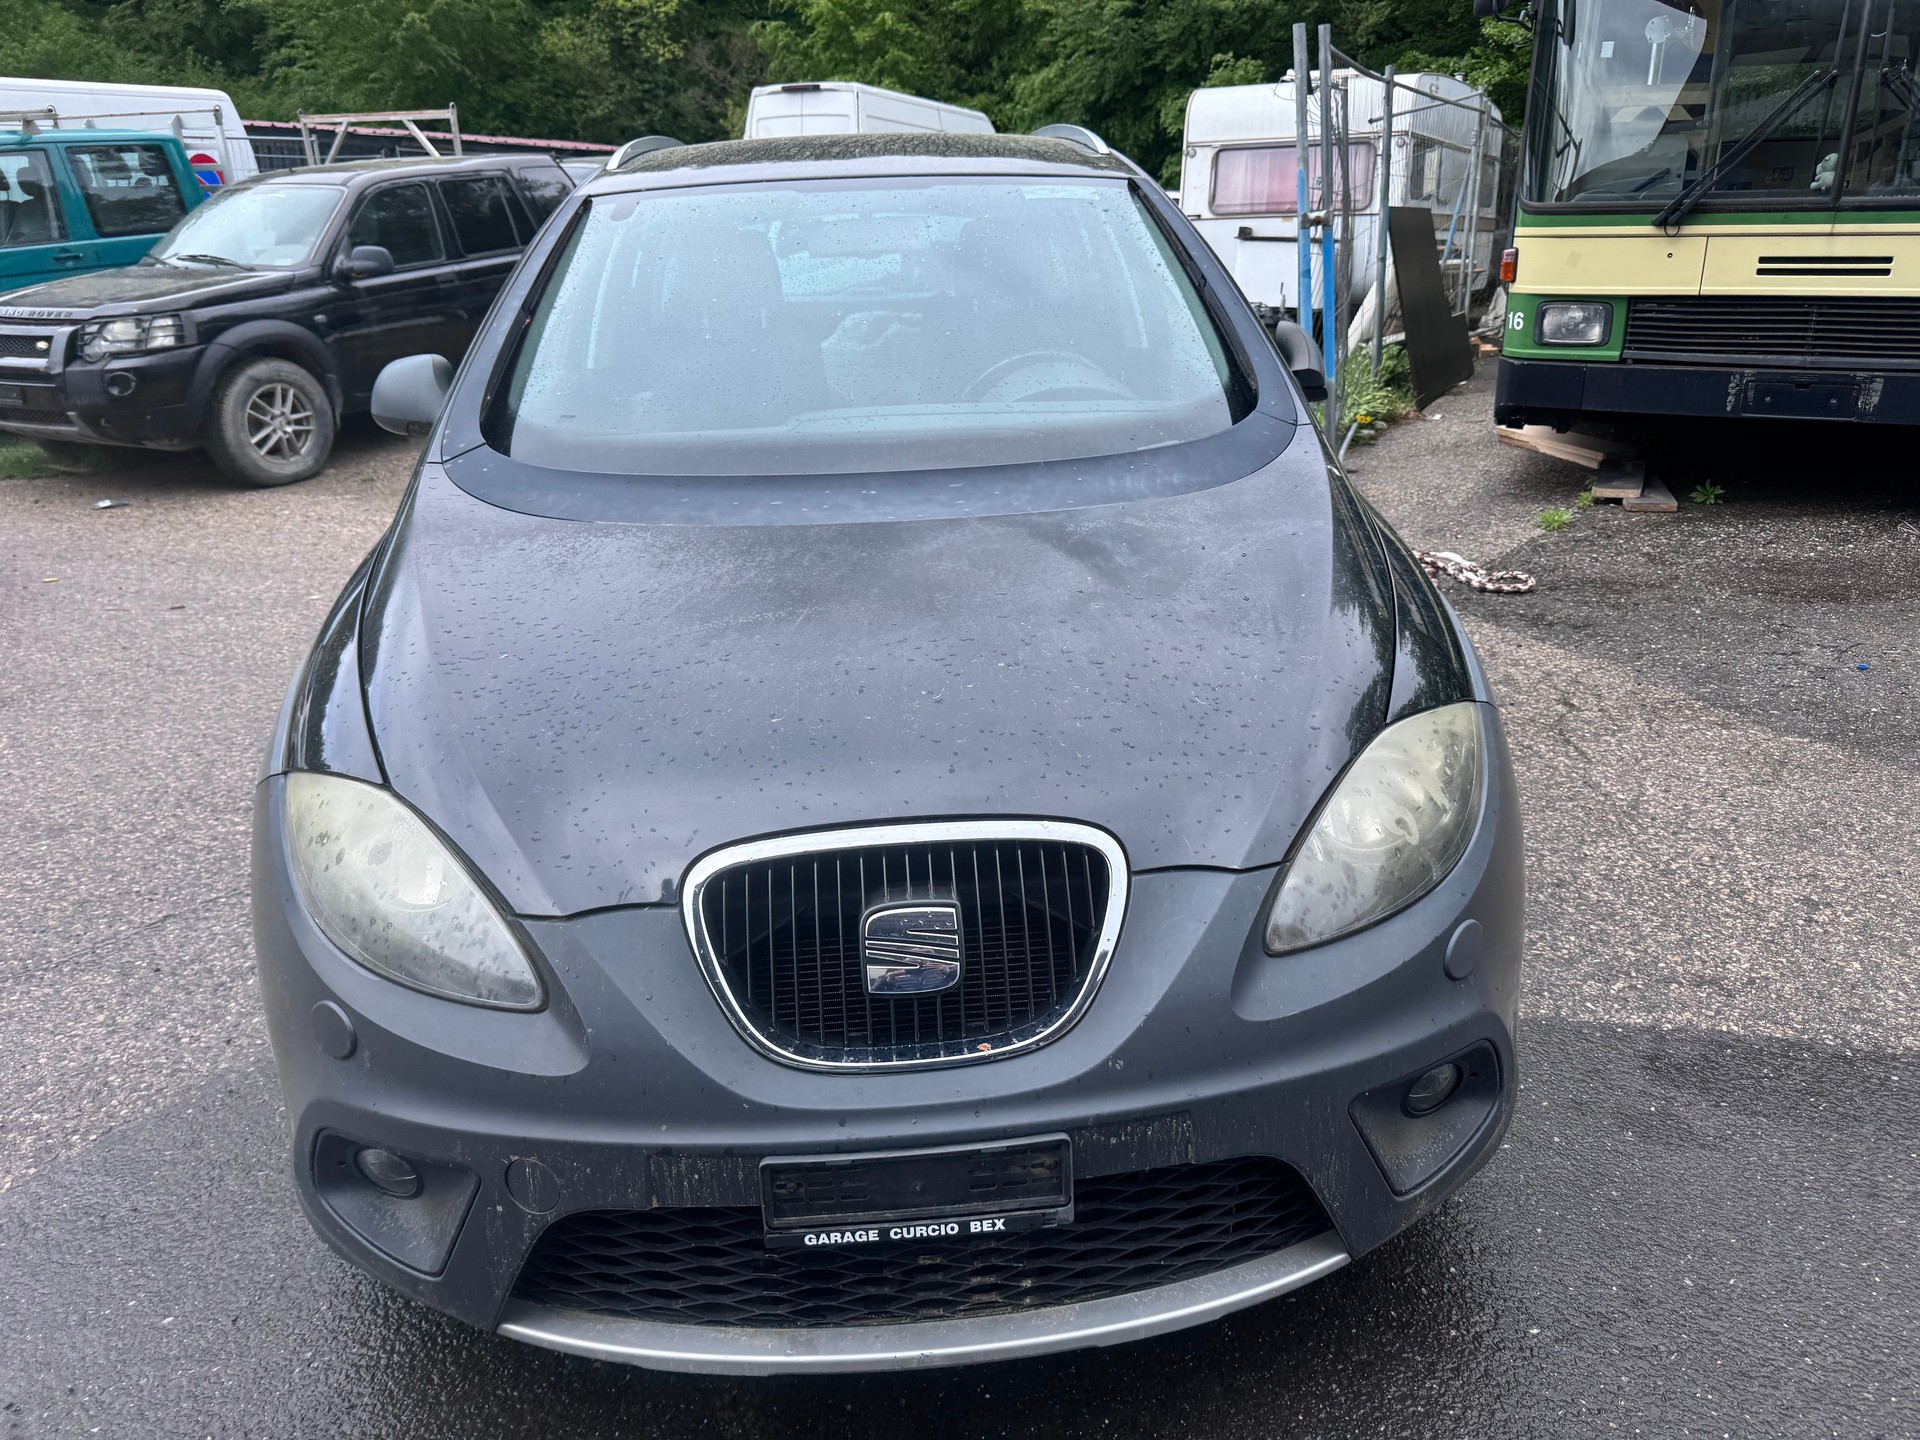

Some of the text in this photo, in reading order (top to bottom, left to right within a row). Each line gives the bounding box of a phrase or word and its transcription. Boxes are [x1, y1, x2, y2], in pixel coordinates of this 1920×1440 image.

[0, 309, 73, 318] AND ROVER
[1508, 311, 1524, 330] 16
[804, 1218, 1006, 1246] GARAGE CURCIO BEX
